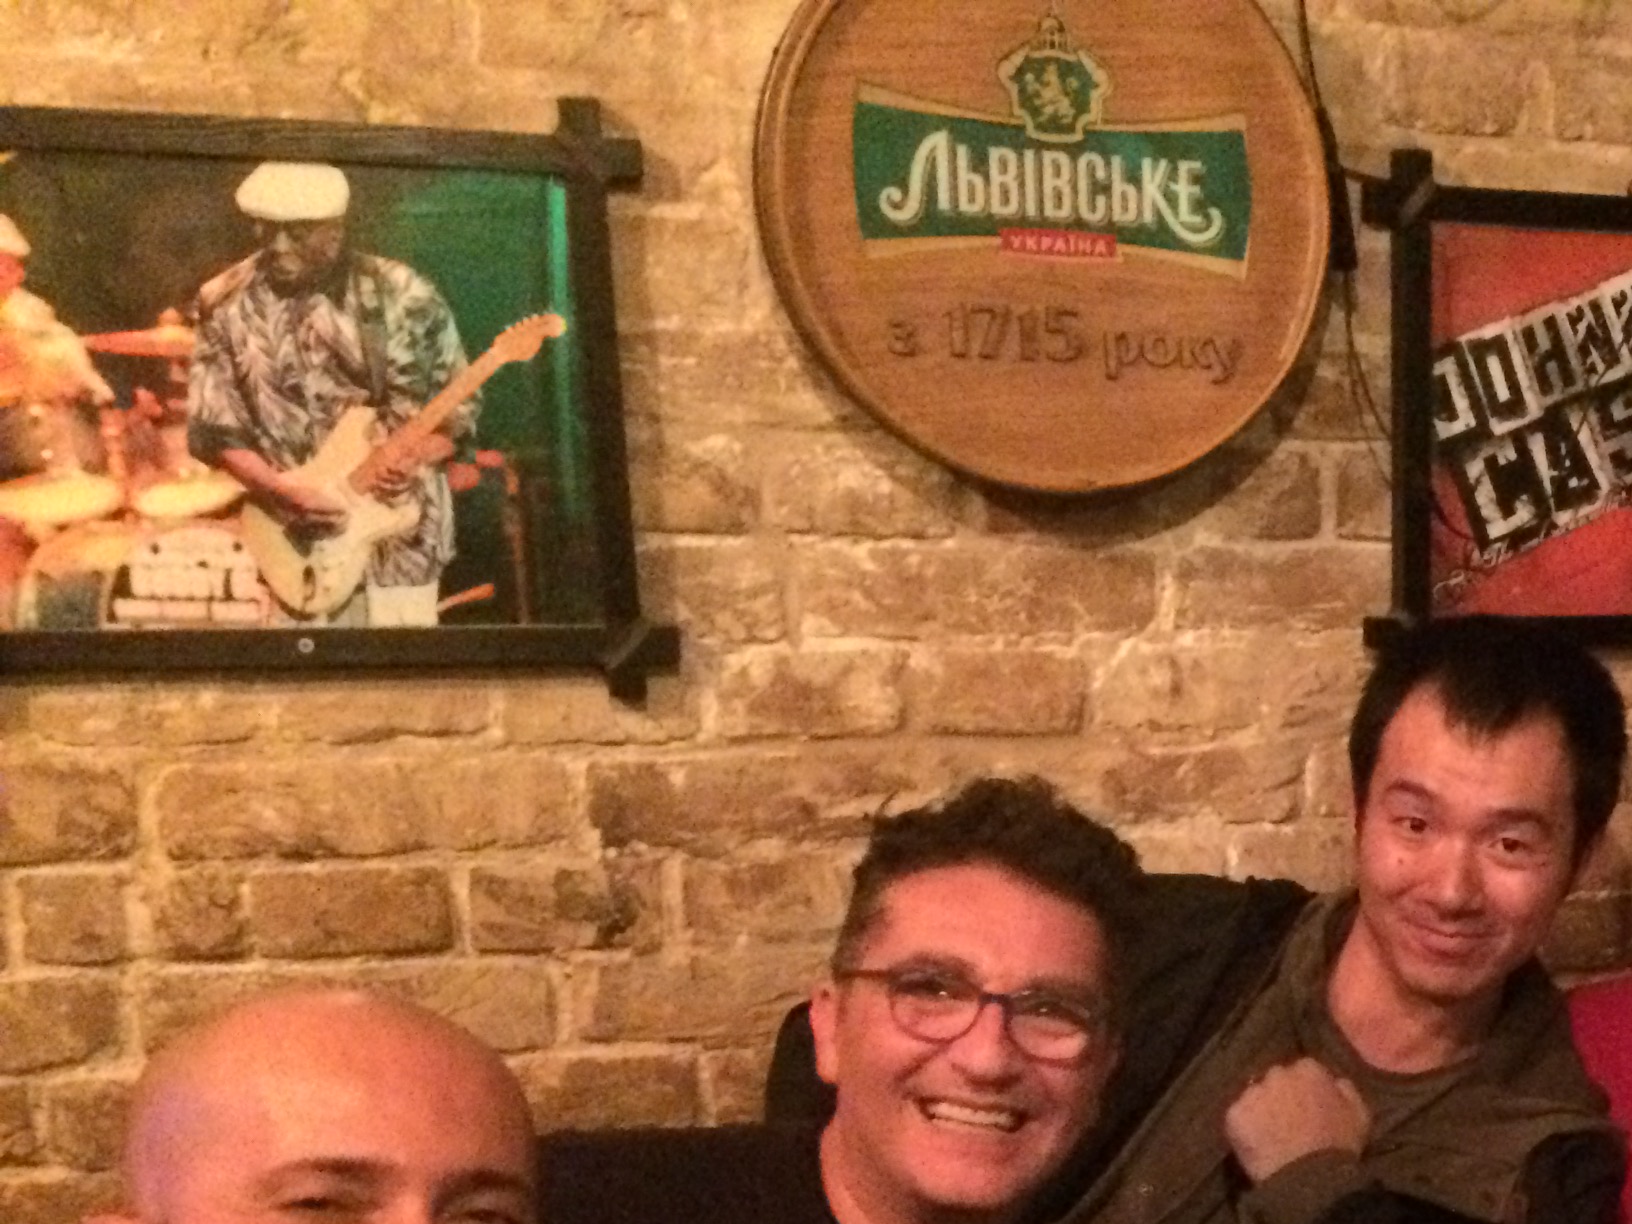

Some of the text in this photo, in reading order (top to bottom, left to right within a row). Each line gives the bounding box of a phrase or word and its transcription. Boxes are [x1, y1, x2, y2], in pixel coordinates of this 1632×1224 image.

[1010, 233, 1108, 255] УКРАЇНА
[942, 302, 1083, 363] 1715
[1102, 331, 1243, 385] року
